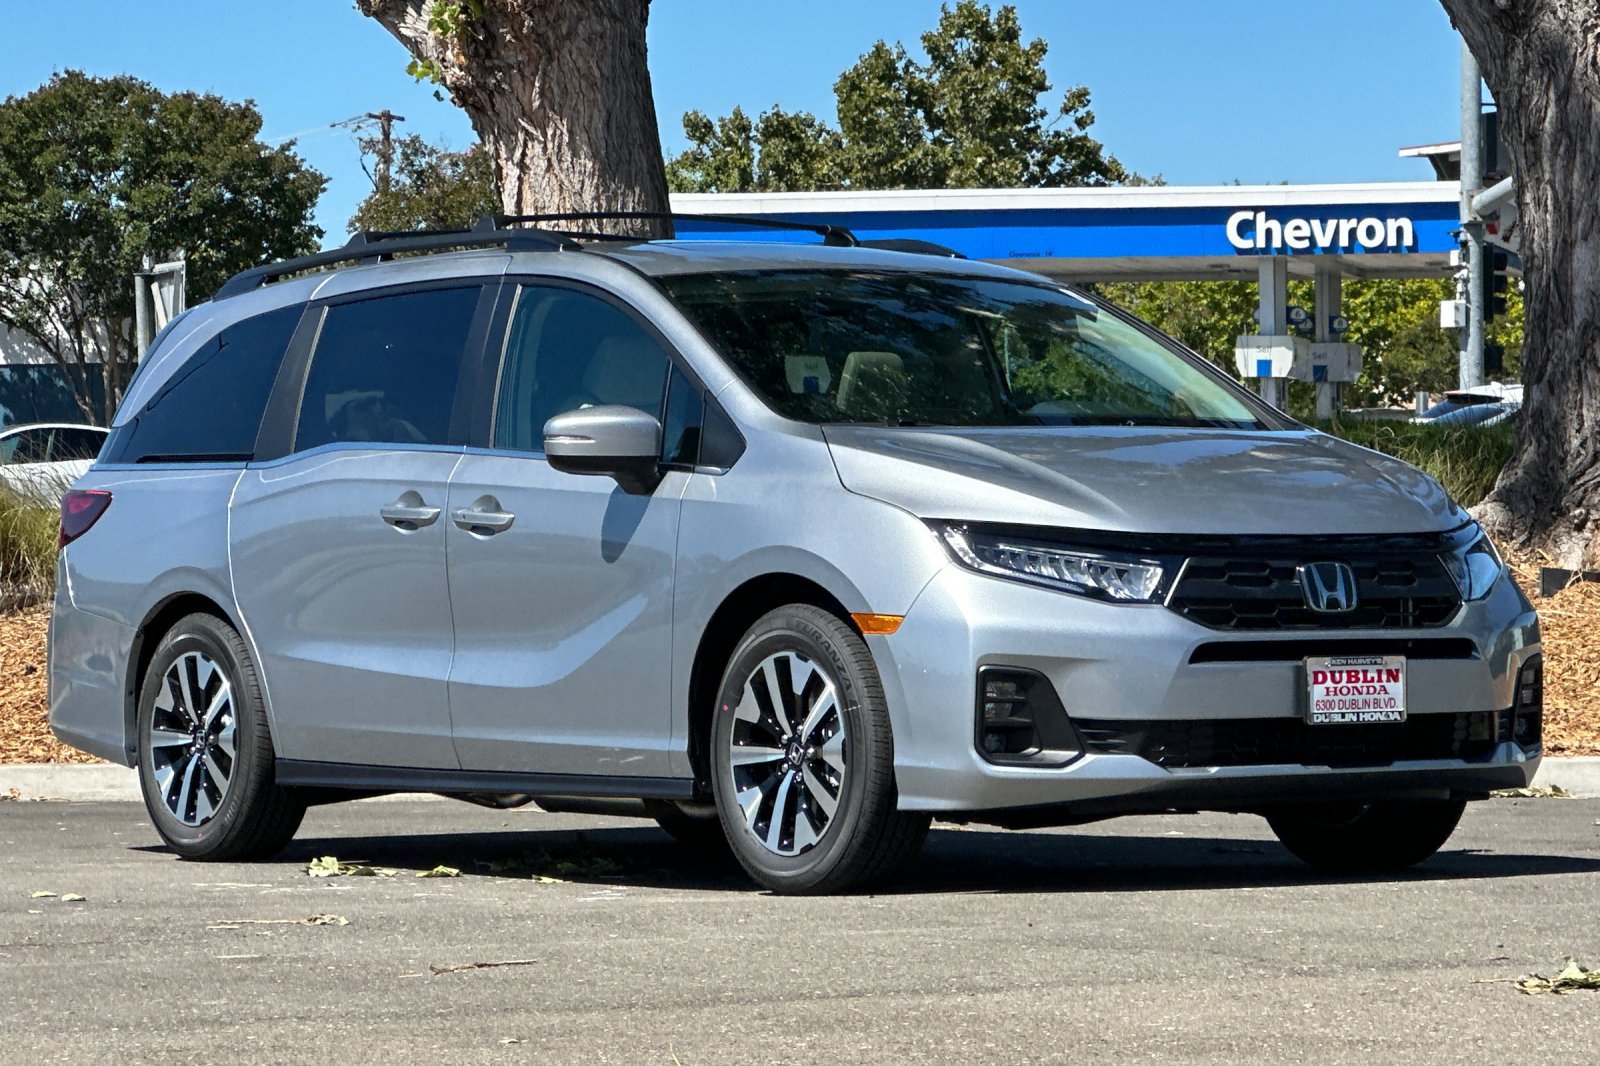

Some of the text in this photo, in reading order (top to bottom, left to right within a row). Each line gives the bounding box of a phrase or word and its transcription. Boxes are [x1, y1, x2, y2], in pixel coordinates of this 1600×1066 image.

[1226, 210, 1413, 249] Chevron
[796, 620, 852, 692] TURANZA
[1312, 668, 1400, 685] DUBLIN
[1324, 685, 1390, 696] HONDA
[1315, 699, 1336, 711] 6300
[1337, 698, 1371, 710] DUBLIN
